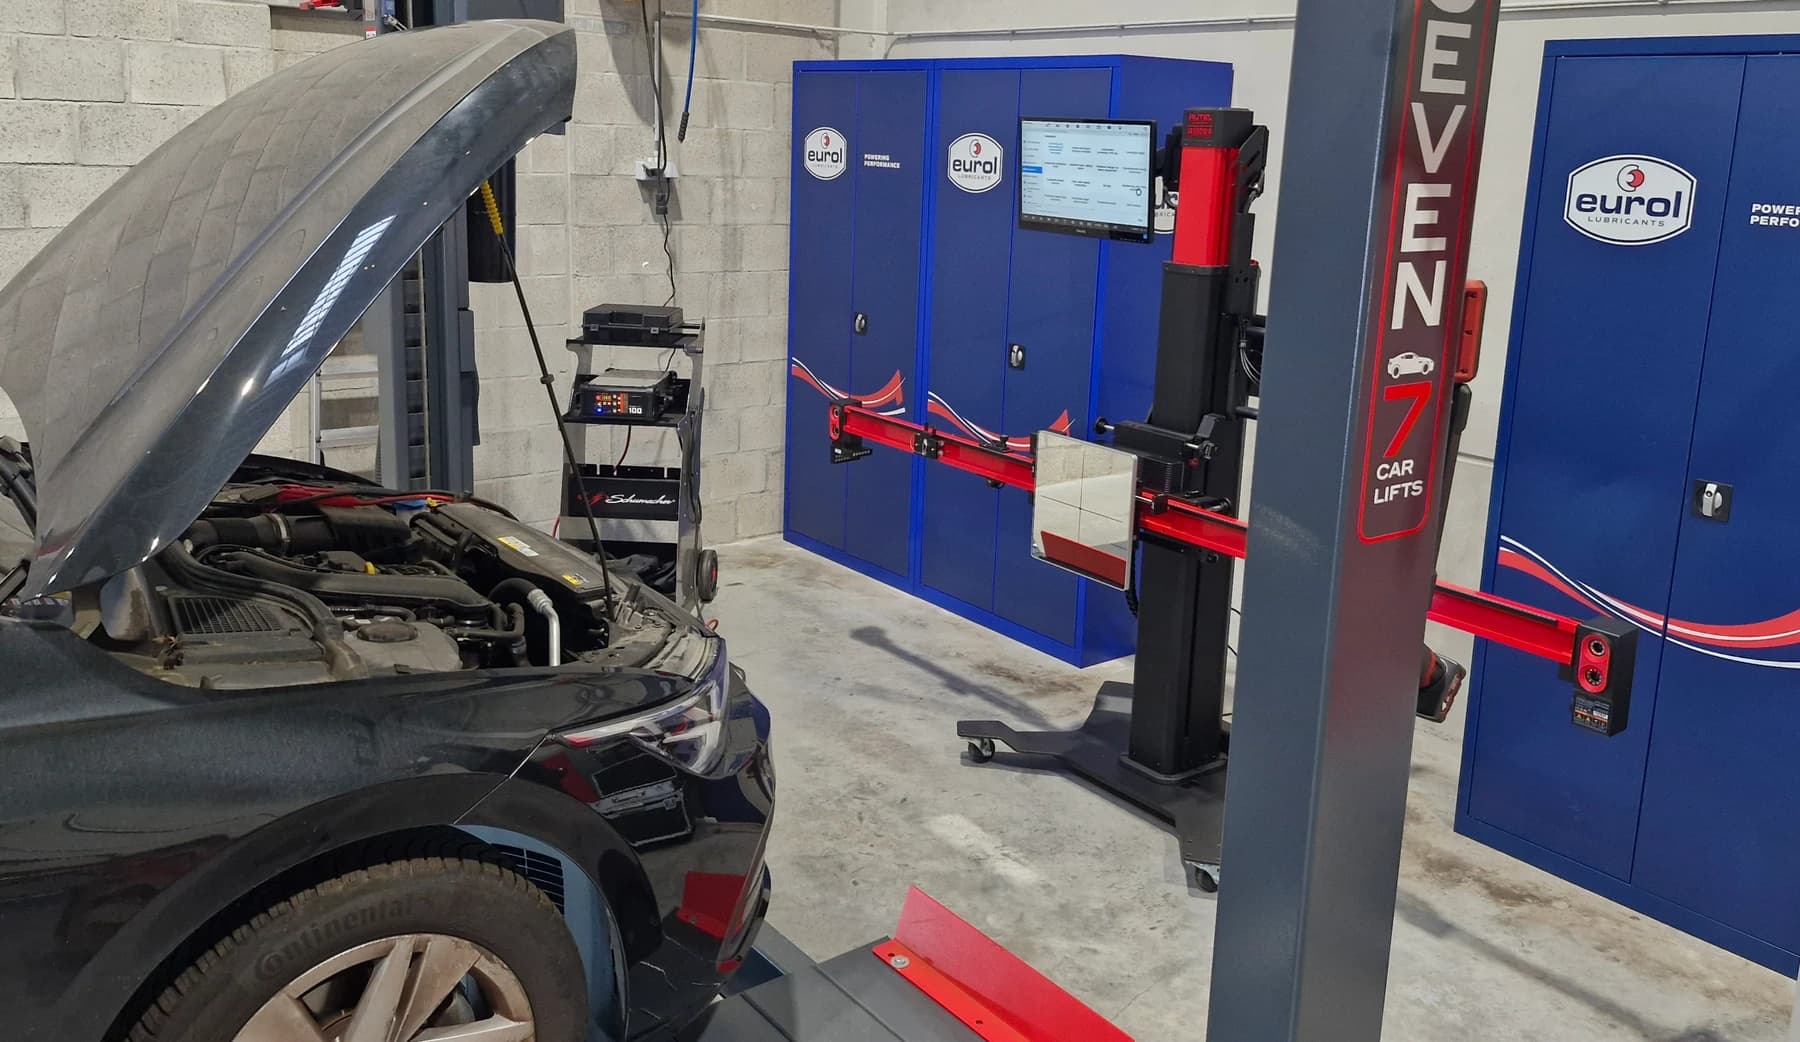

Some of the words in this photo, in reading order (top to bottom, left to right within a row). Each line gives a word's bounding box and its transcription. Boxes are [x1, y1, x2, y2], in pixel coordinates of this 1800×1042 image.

[807, 148, 843, 163] eurol
[863, 160, 901, 169] PERFORMANCE
[952, 156, 998, 175] eurol
[1391, 0, 1476, 329] EVEN
[1575, 191, 1683, 218] eurol
[1587, 216, 1664, 227] LUBRICANTS
[1382, 381, 1432, 459] 7
[1376, 459, 1414, 481] CAR
[1373, 480, 1424, 505] LIFTS
